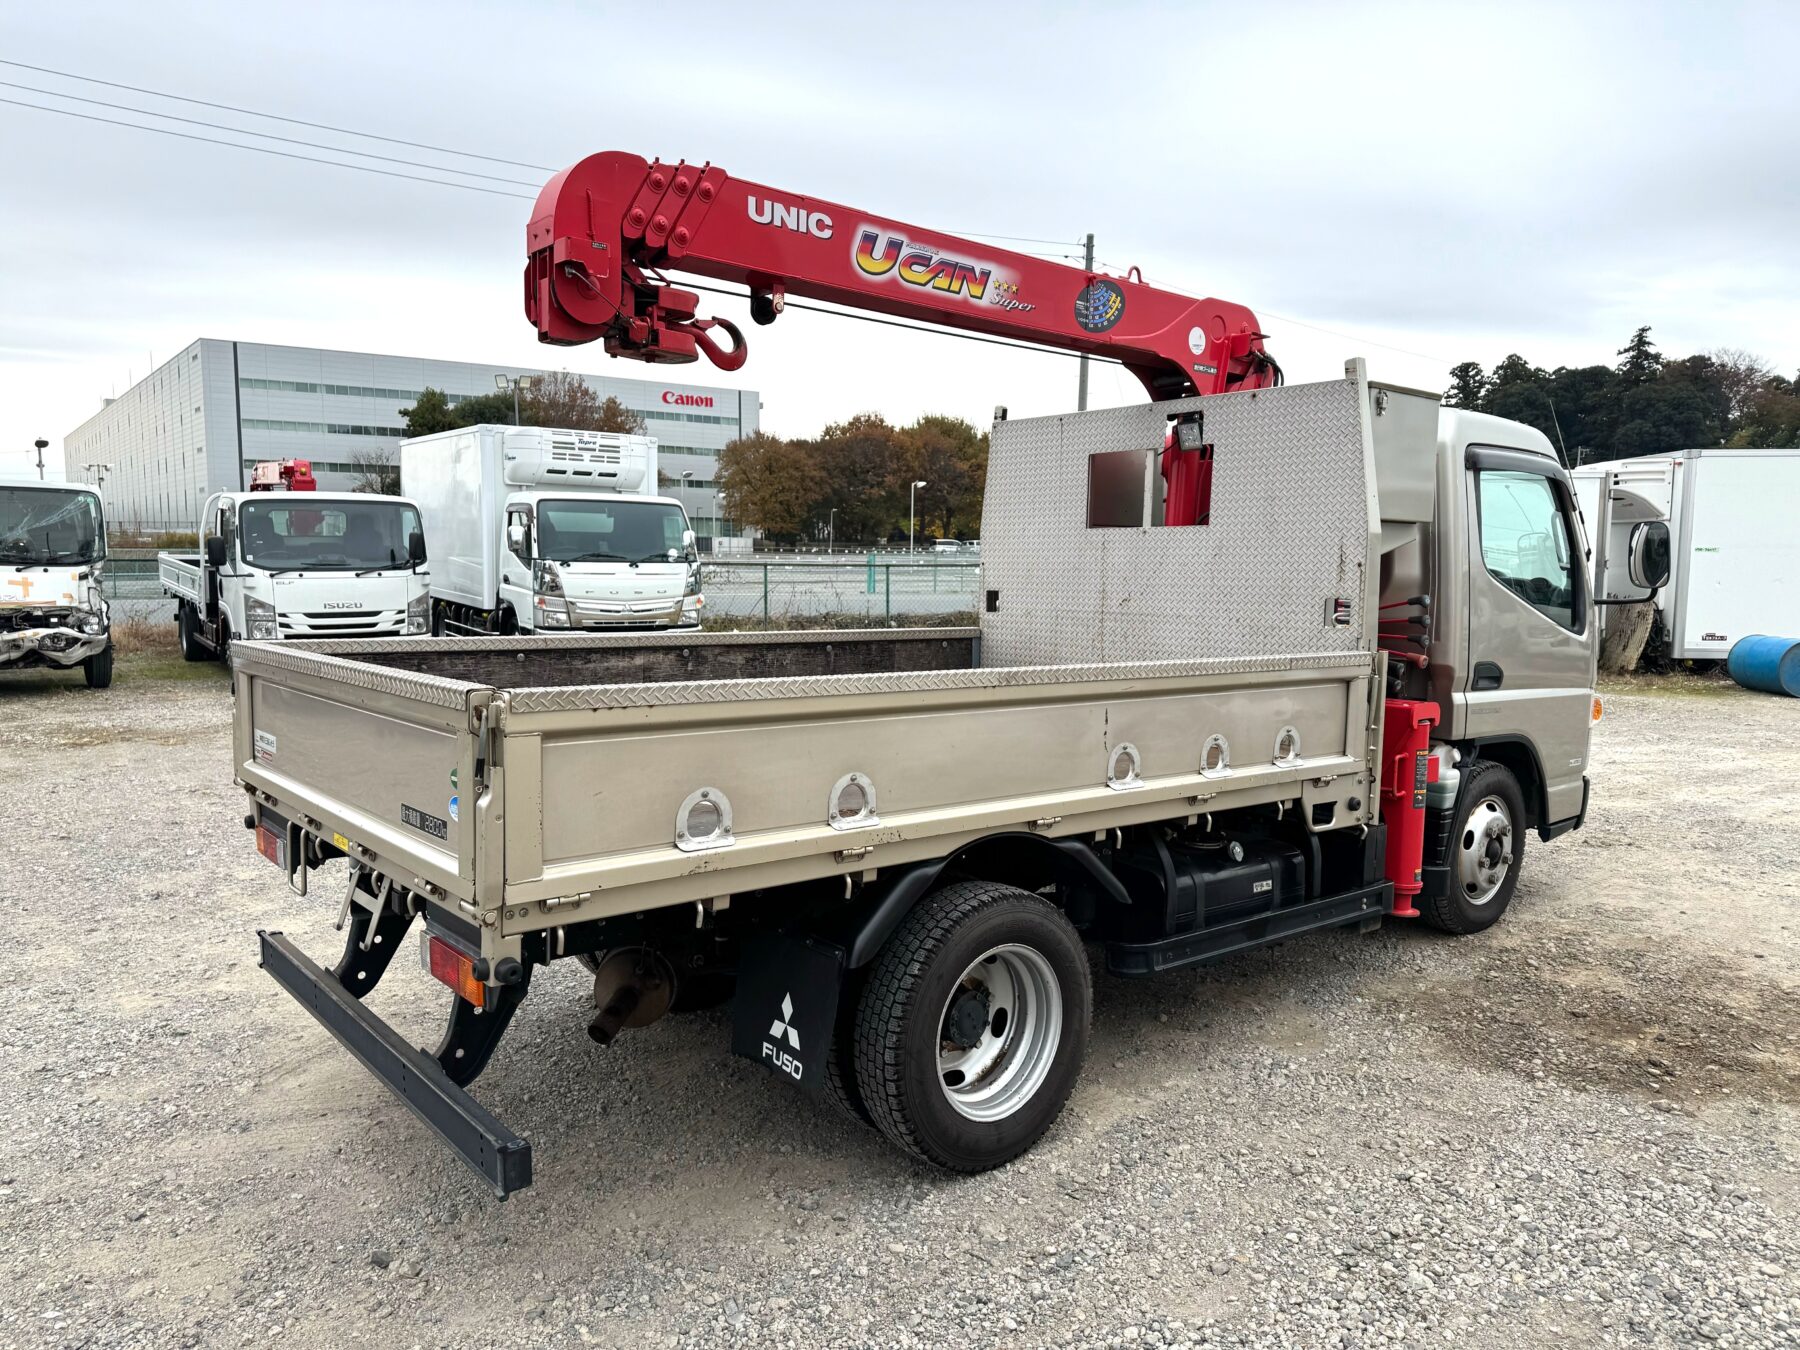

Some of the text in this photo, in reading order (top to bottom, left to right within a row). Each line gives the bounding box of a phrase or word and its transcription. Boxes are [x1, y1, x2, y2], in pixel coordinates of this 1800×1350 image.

[747, 195, 833, 239] UNIC
[990, 292, 1035, 312] Super
[661, 390, 714, 408] Canon
[323, 602, 363, 610] ISUZU
[762, 1041, 803, 1080] FUSO
